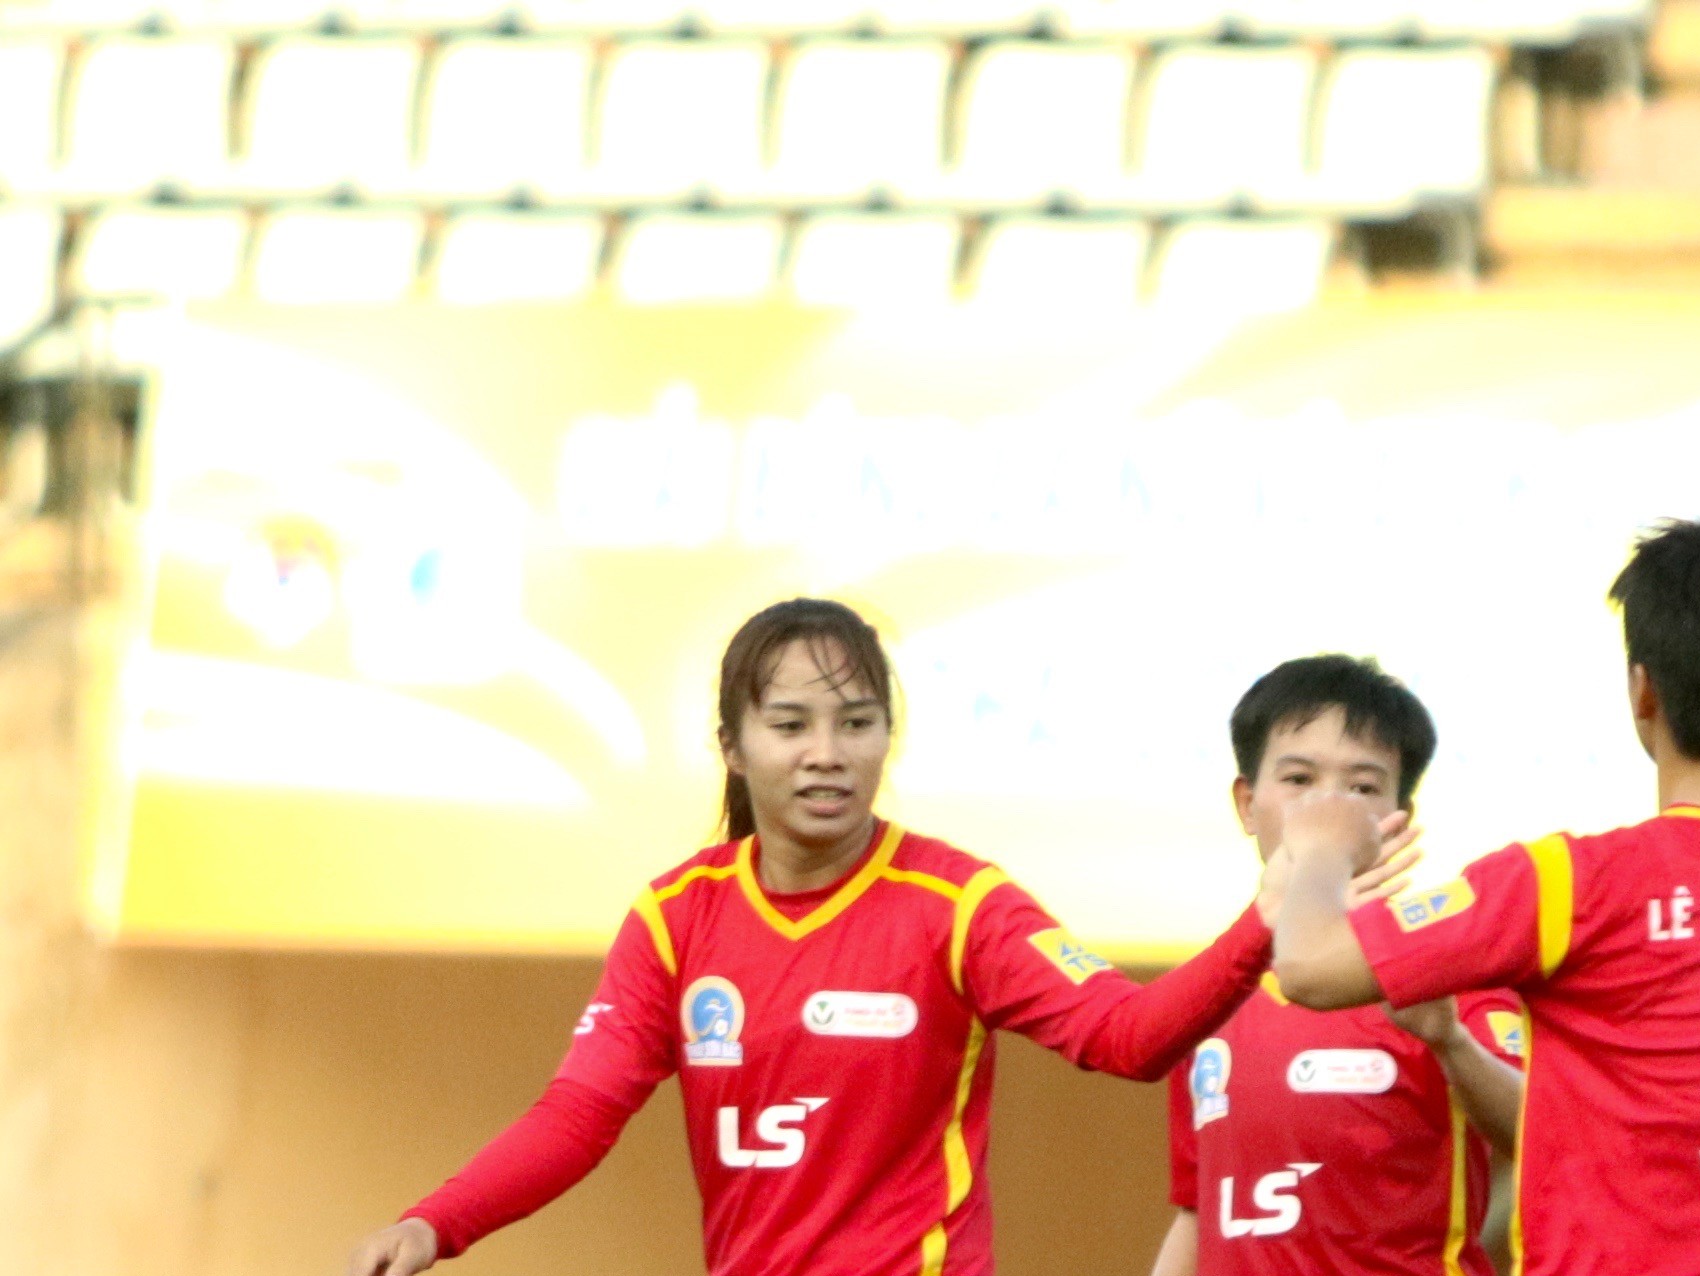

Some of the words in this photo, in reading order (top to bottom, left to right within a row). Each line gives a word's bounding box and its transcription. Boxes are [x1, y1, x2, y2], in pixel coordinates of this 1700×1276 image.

[1648, 885, 1695, 941] LÊ
[718, 1098, 830, 1167] LS
[1220, 1163, 1324, 1238] LS
